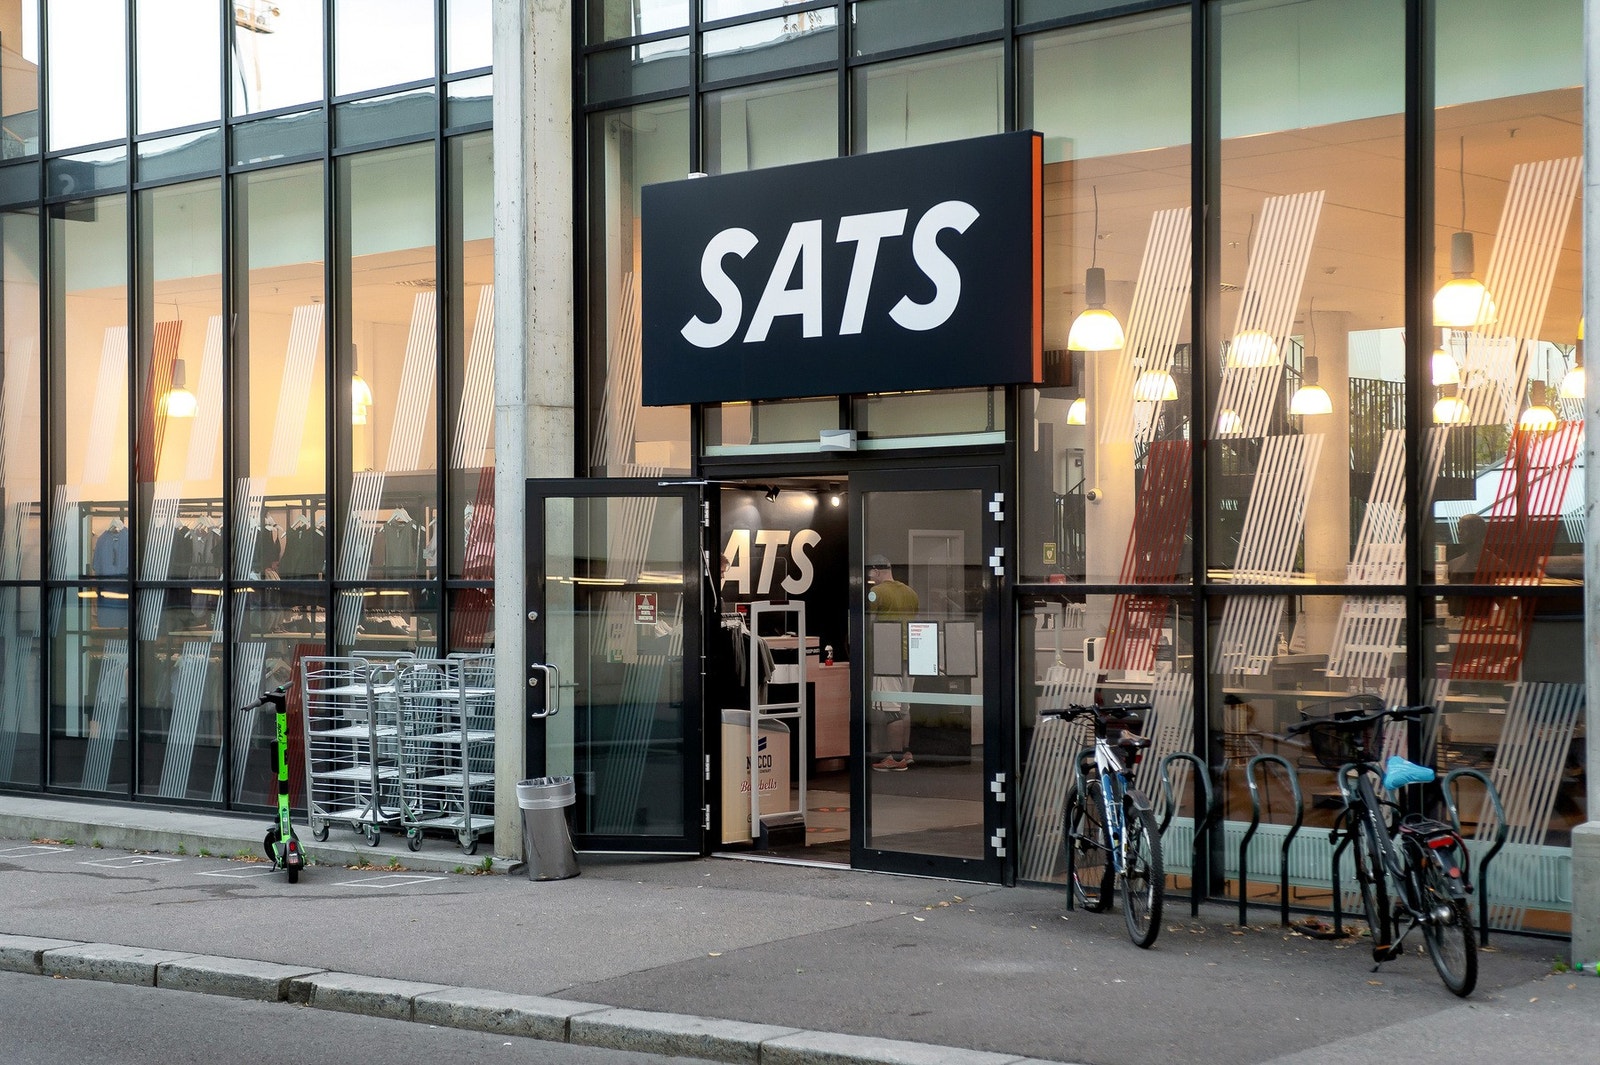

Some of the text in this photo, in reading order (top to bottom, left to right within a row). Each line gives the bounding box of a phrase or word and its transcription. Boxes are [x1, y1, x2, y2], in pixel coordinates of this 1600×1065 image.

[680, 200, 981, 349] SATS
[747, 755, 772, 769] NCCO
[741, 779, 777, 793] Babells
